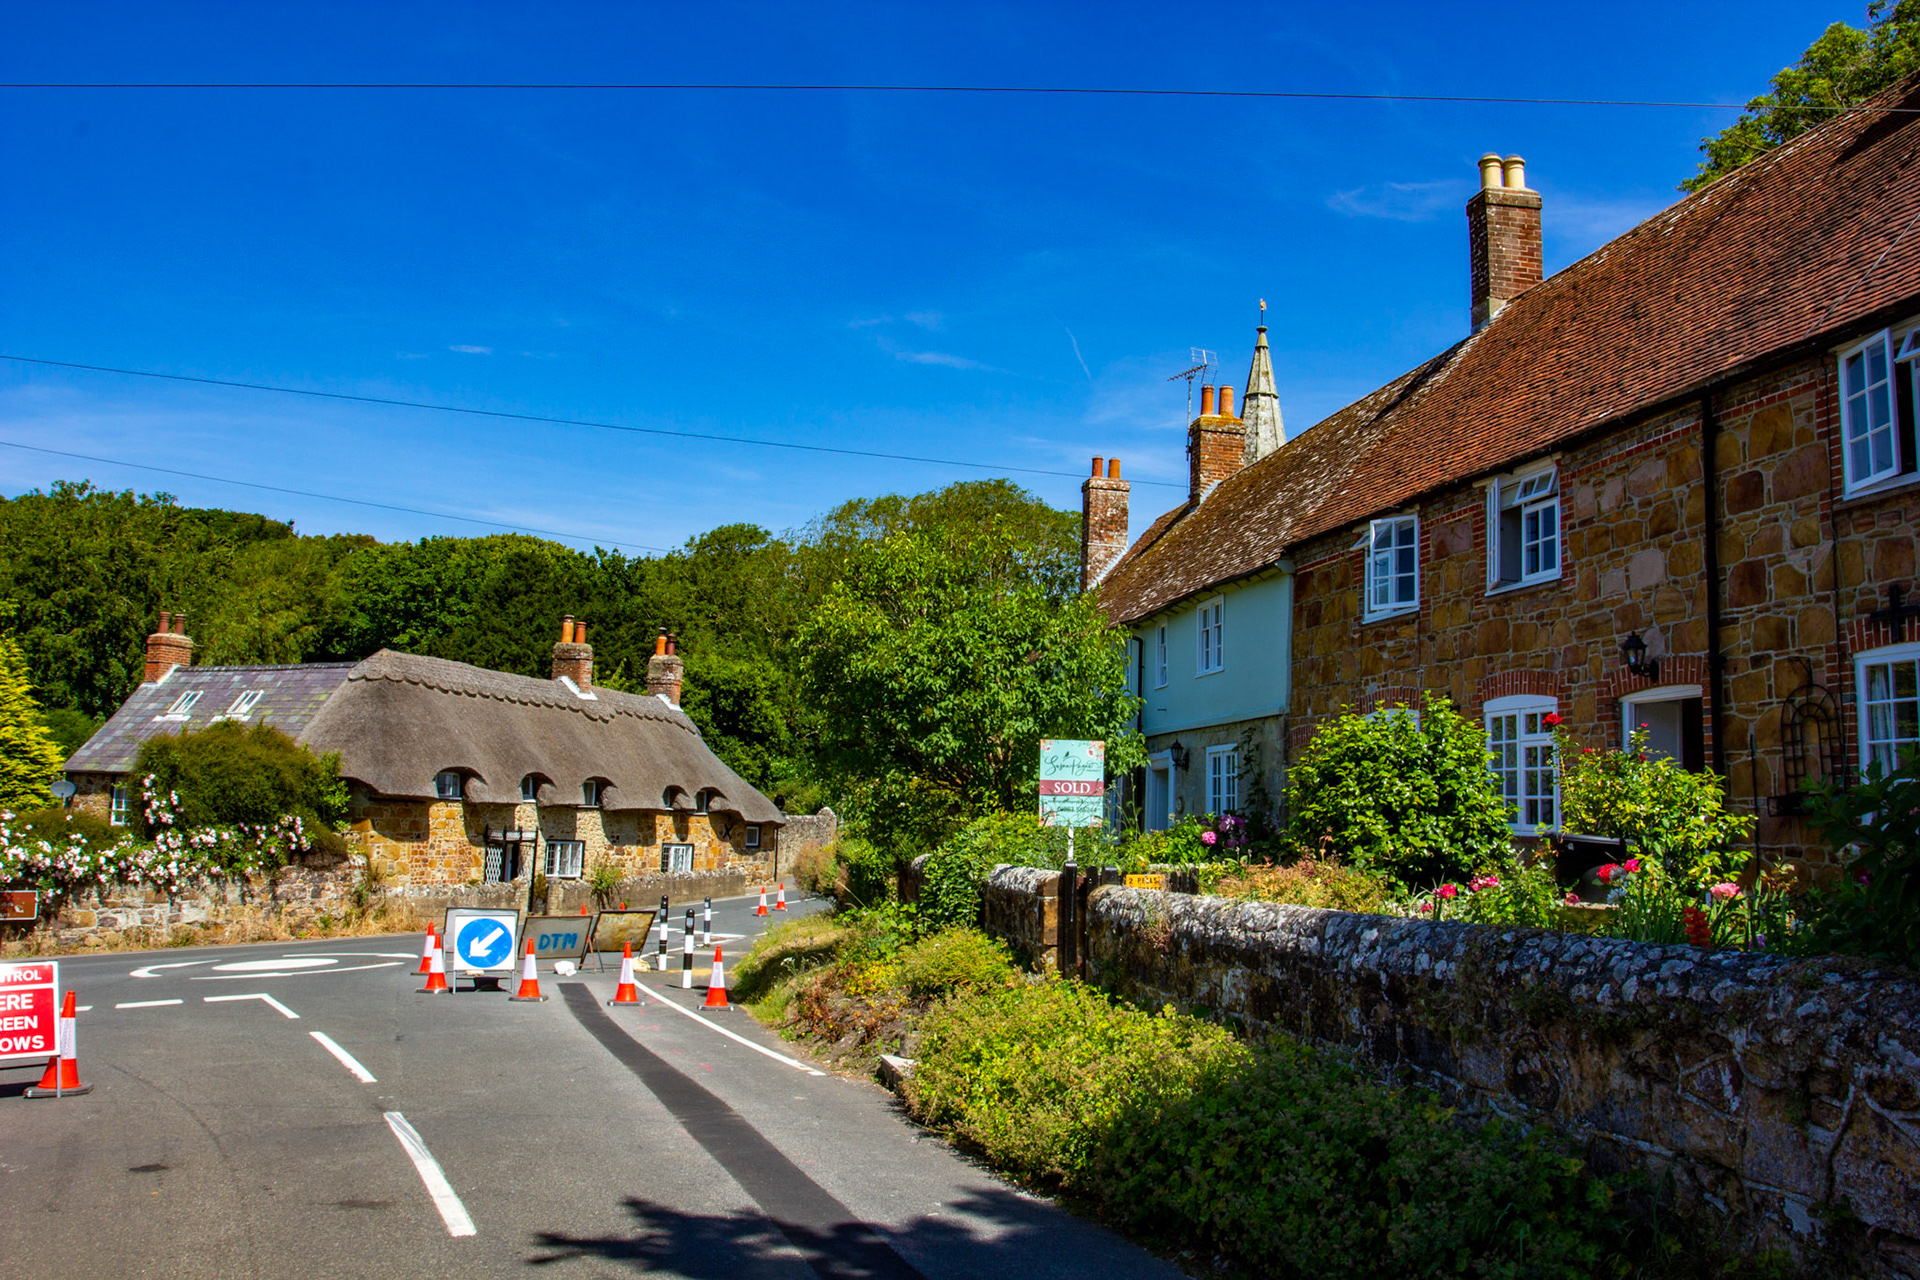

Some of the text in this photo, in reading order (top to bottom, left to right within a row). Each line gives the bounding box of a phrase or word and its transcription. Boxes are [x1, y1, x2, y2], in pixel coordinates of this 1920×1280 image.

[1054, 782, 1090, 794] SOLD
[538, 932, 578, 950] DTM
[0, 970, 42, 983] TROL
[0, 1015, 38, 1032] EEN
